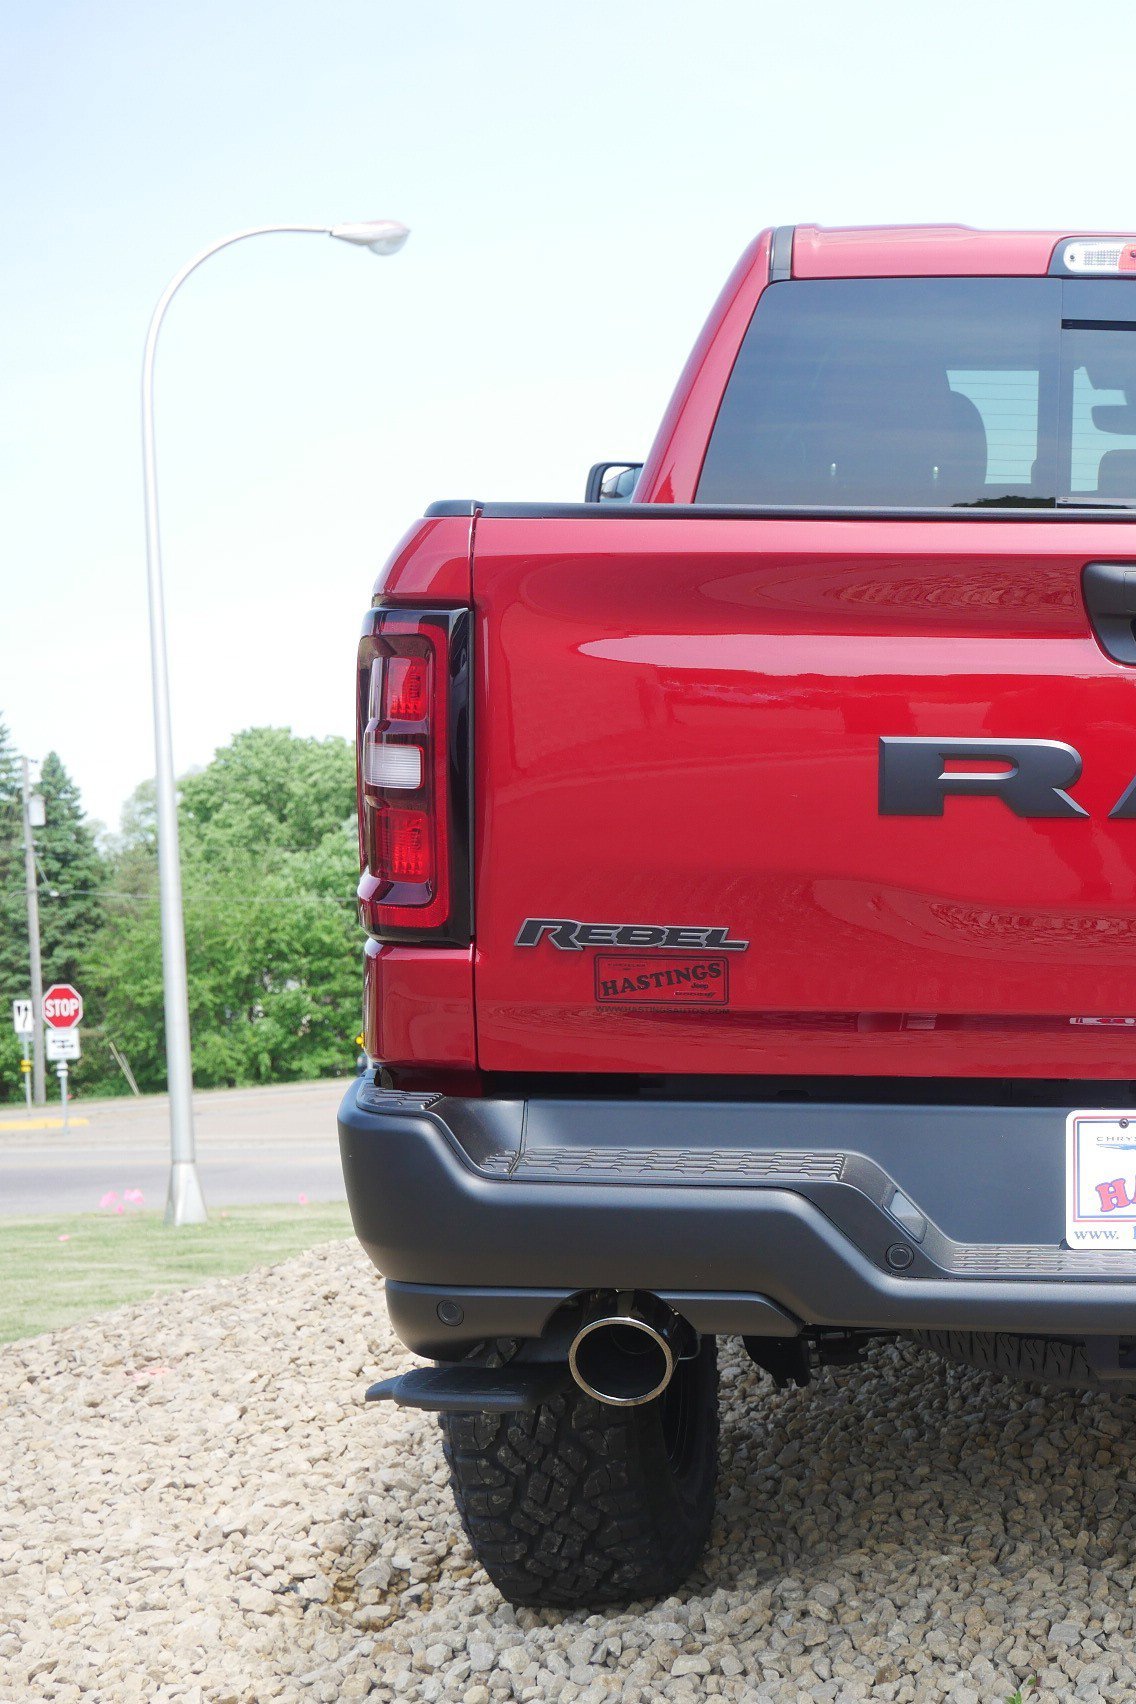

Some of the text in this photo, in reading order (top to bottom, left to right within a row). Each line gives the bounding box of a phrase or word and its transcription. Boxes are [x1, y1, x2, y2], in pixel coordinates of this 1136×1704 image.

[514, 917, 750, 951] REBEL
[601, 962, 721, 997] HASTINGS
[45, 998, 79, 1018] STOP
[1073, 1229, 1120, 1240] www.
